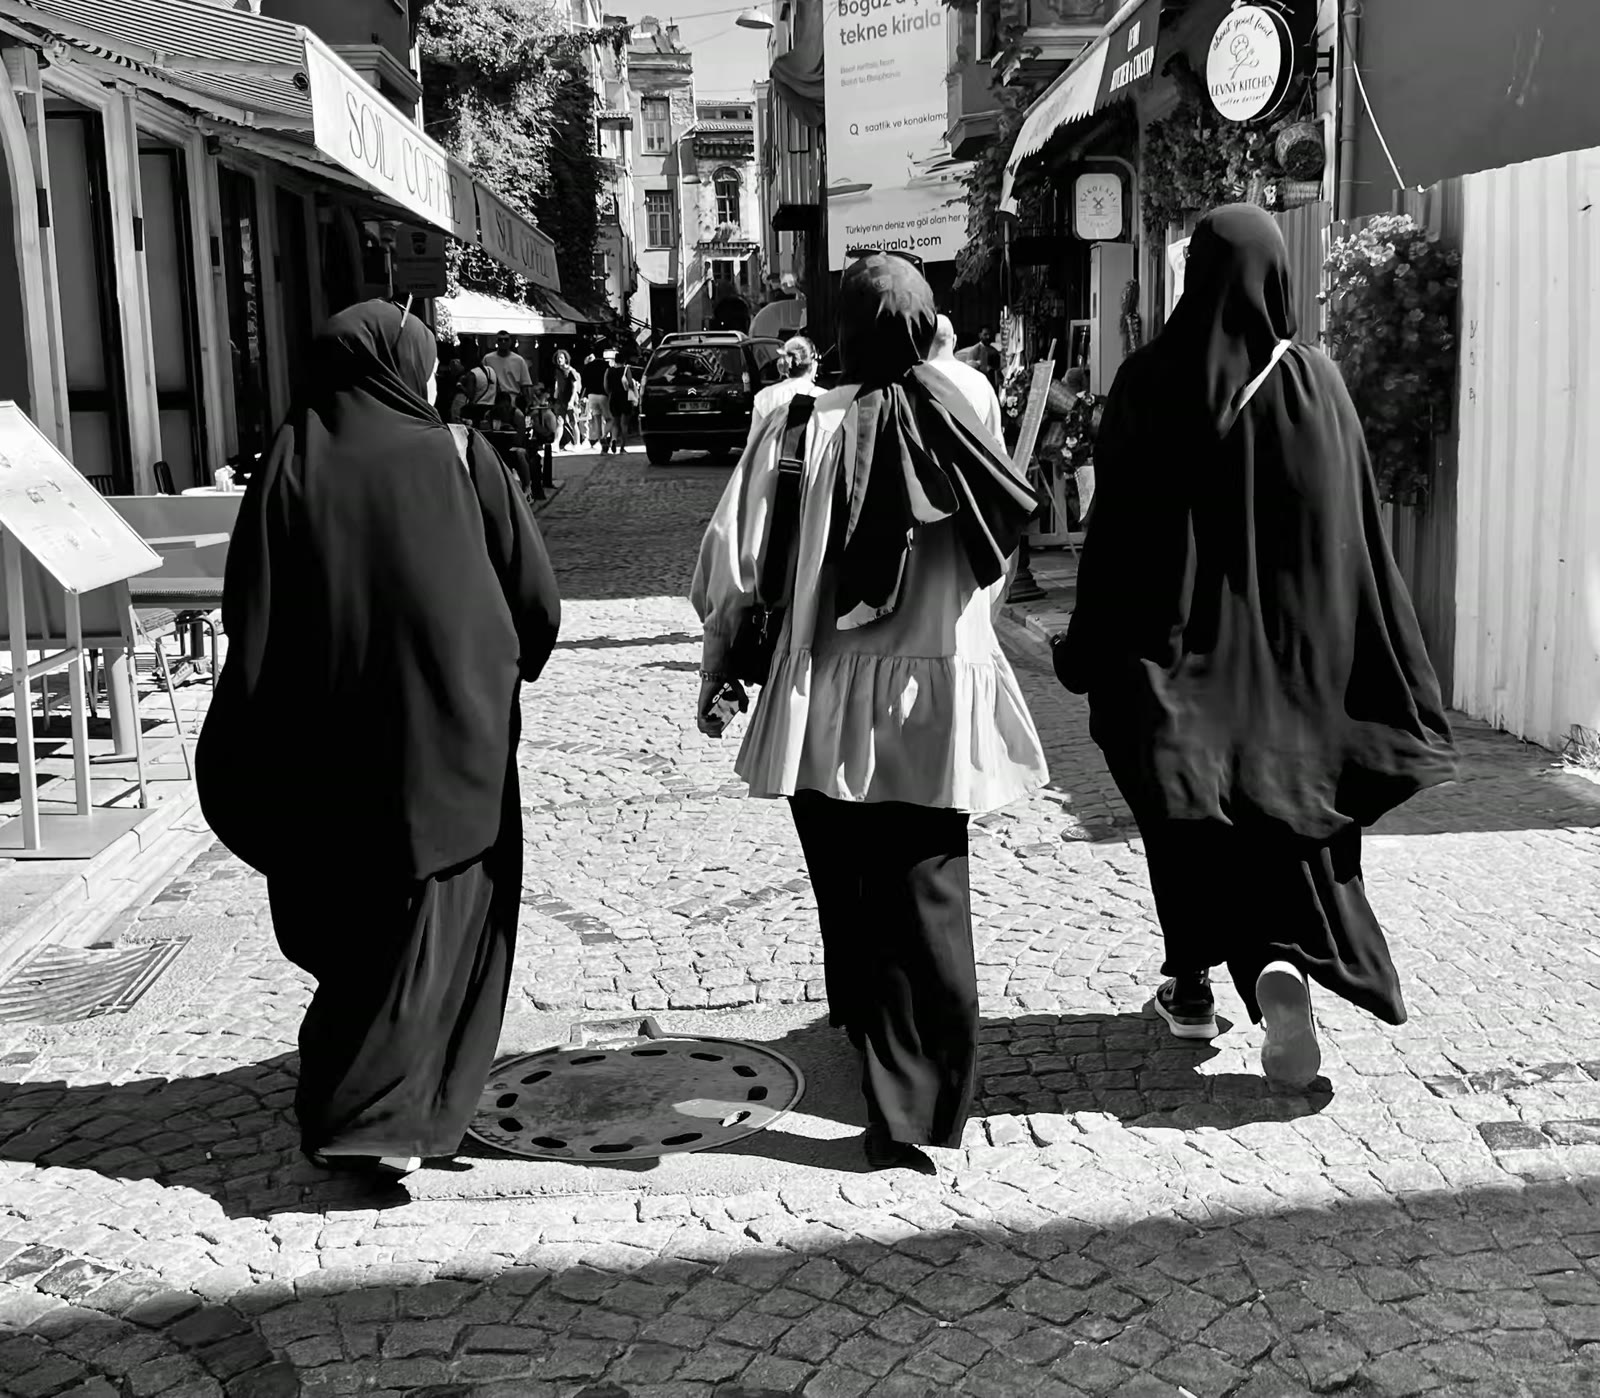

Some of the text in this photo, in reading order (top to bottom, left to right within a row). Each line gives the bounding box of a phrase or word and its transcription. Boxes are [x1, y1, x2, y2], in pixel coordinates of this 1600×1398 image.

[840, 9, 941, 45] tekne kirala
[1212, 13, 1274, 51] about good food
[1239, 75, 1275, 92] KITCHEN
[864, 119, 891, 132] saatlik
[892, 120, 902, 128] ve
[345, 90, 461, 225] SOIL COFFEE
[845, 223, 884, 235] Türkiye'nin
[884, 220, 905, 231] deniz
[906, 220, 915, 228] ve
[916, 216, 929, 228] göl
[929, 215, 947, 225] olan
[948, 214, 961, 222] her
